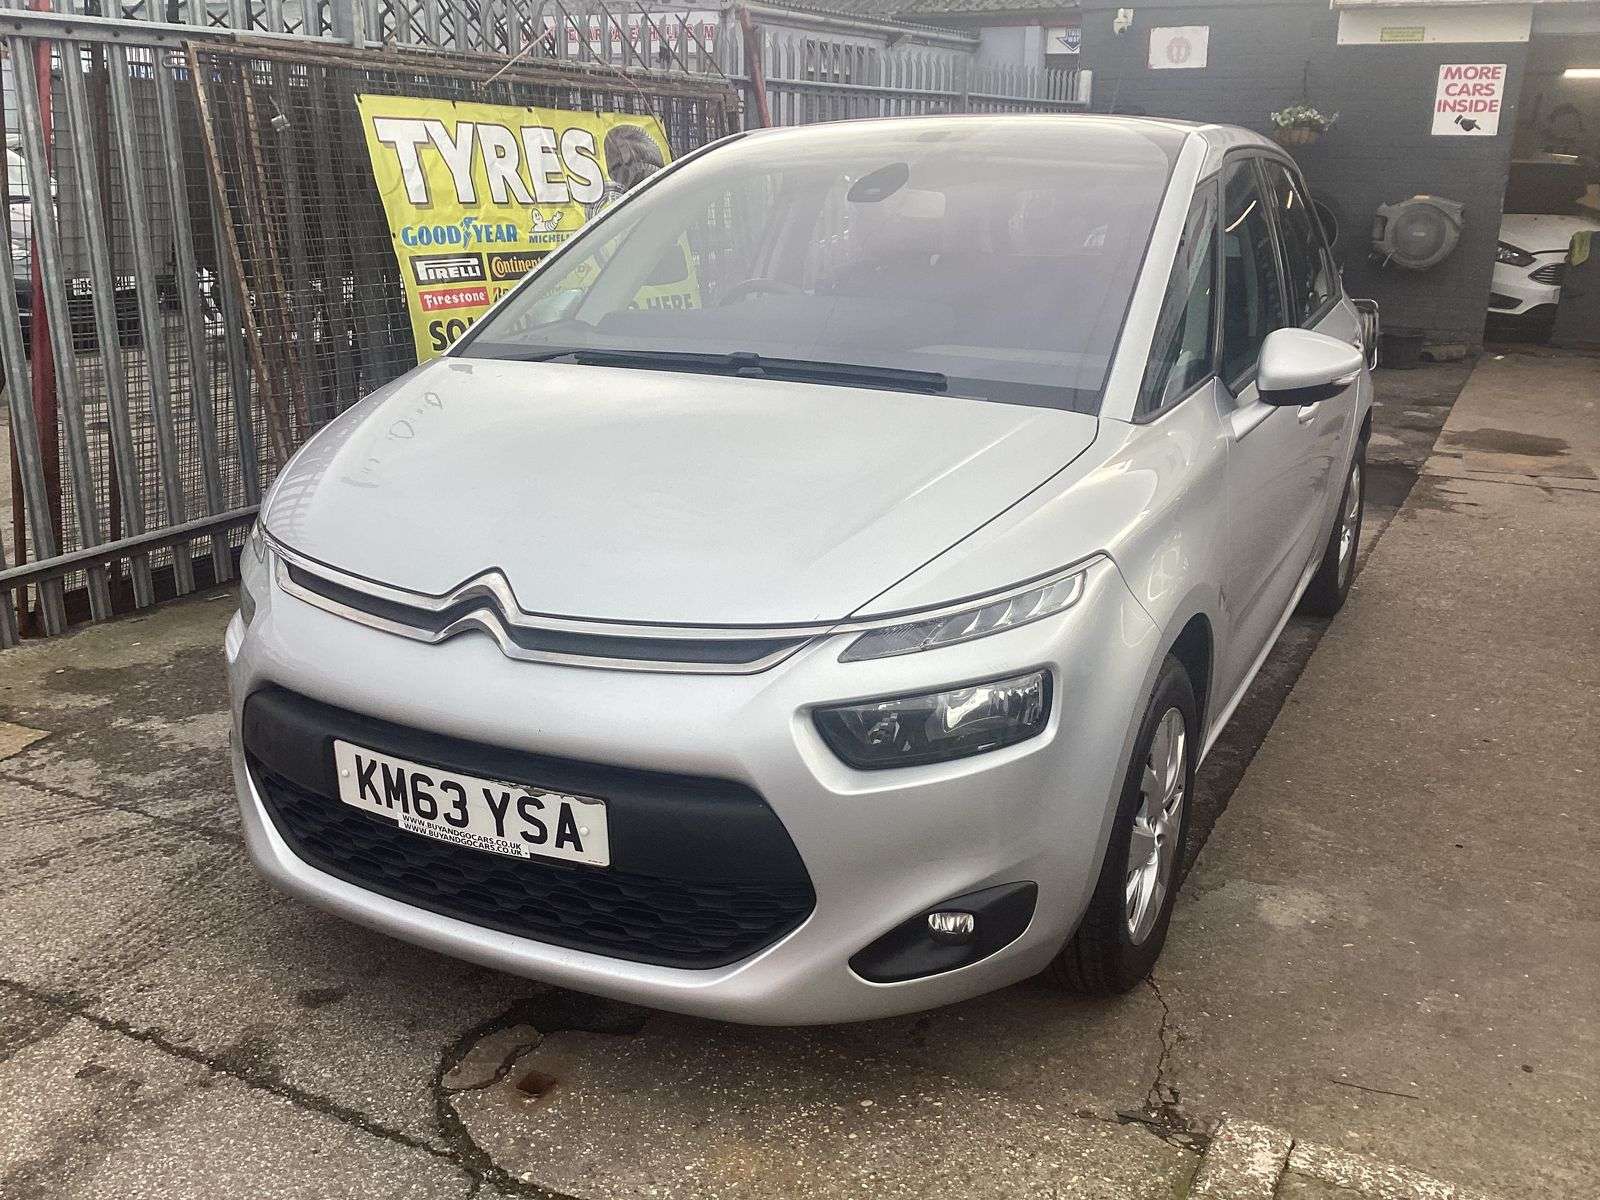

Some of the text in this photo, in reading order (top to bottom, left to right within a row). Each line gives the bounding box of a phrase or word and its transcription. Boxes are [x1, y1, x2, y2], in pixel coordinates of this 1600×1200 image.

[1444, 66, 1502, 80] MORE
[1445, 83, 1495, 96] CARS
[1437, 99, 1499, 113] INSIDE
[372, 116, 605, 206] TYRES
[416, 258, 481, 281] PIRELLI
[423, 291, 486, 309] Firestone
[354, 754, 584, 853] KM63 YSA
[402, 814, 522, 850] WWW.BUYANDGOCARS.CO.UK
[404, 823, 523, 857] WWW.BUYANDGOCARS.CO.UK
